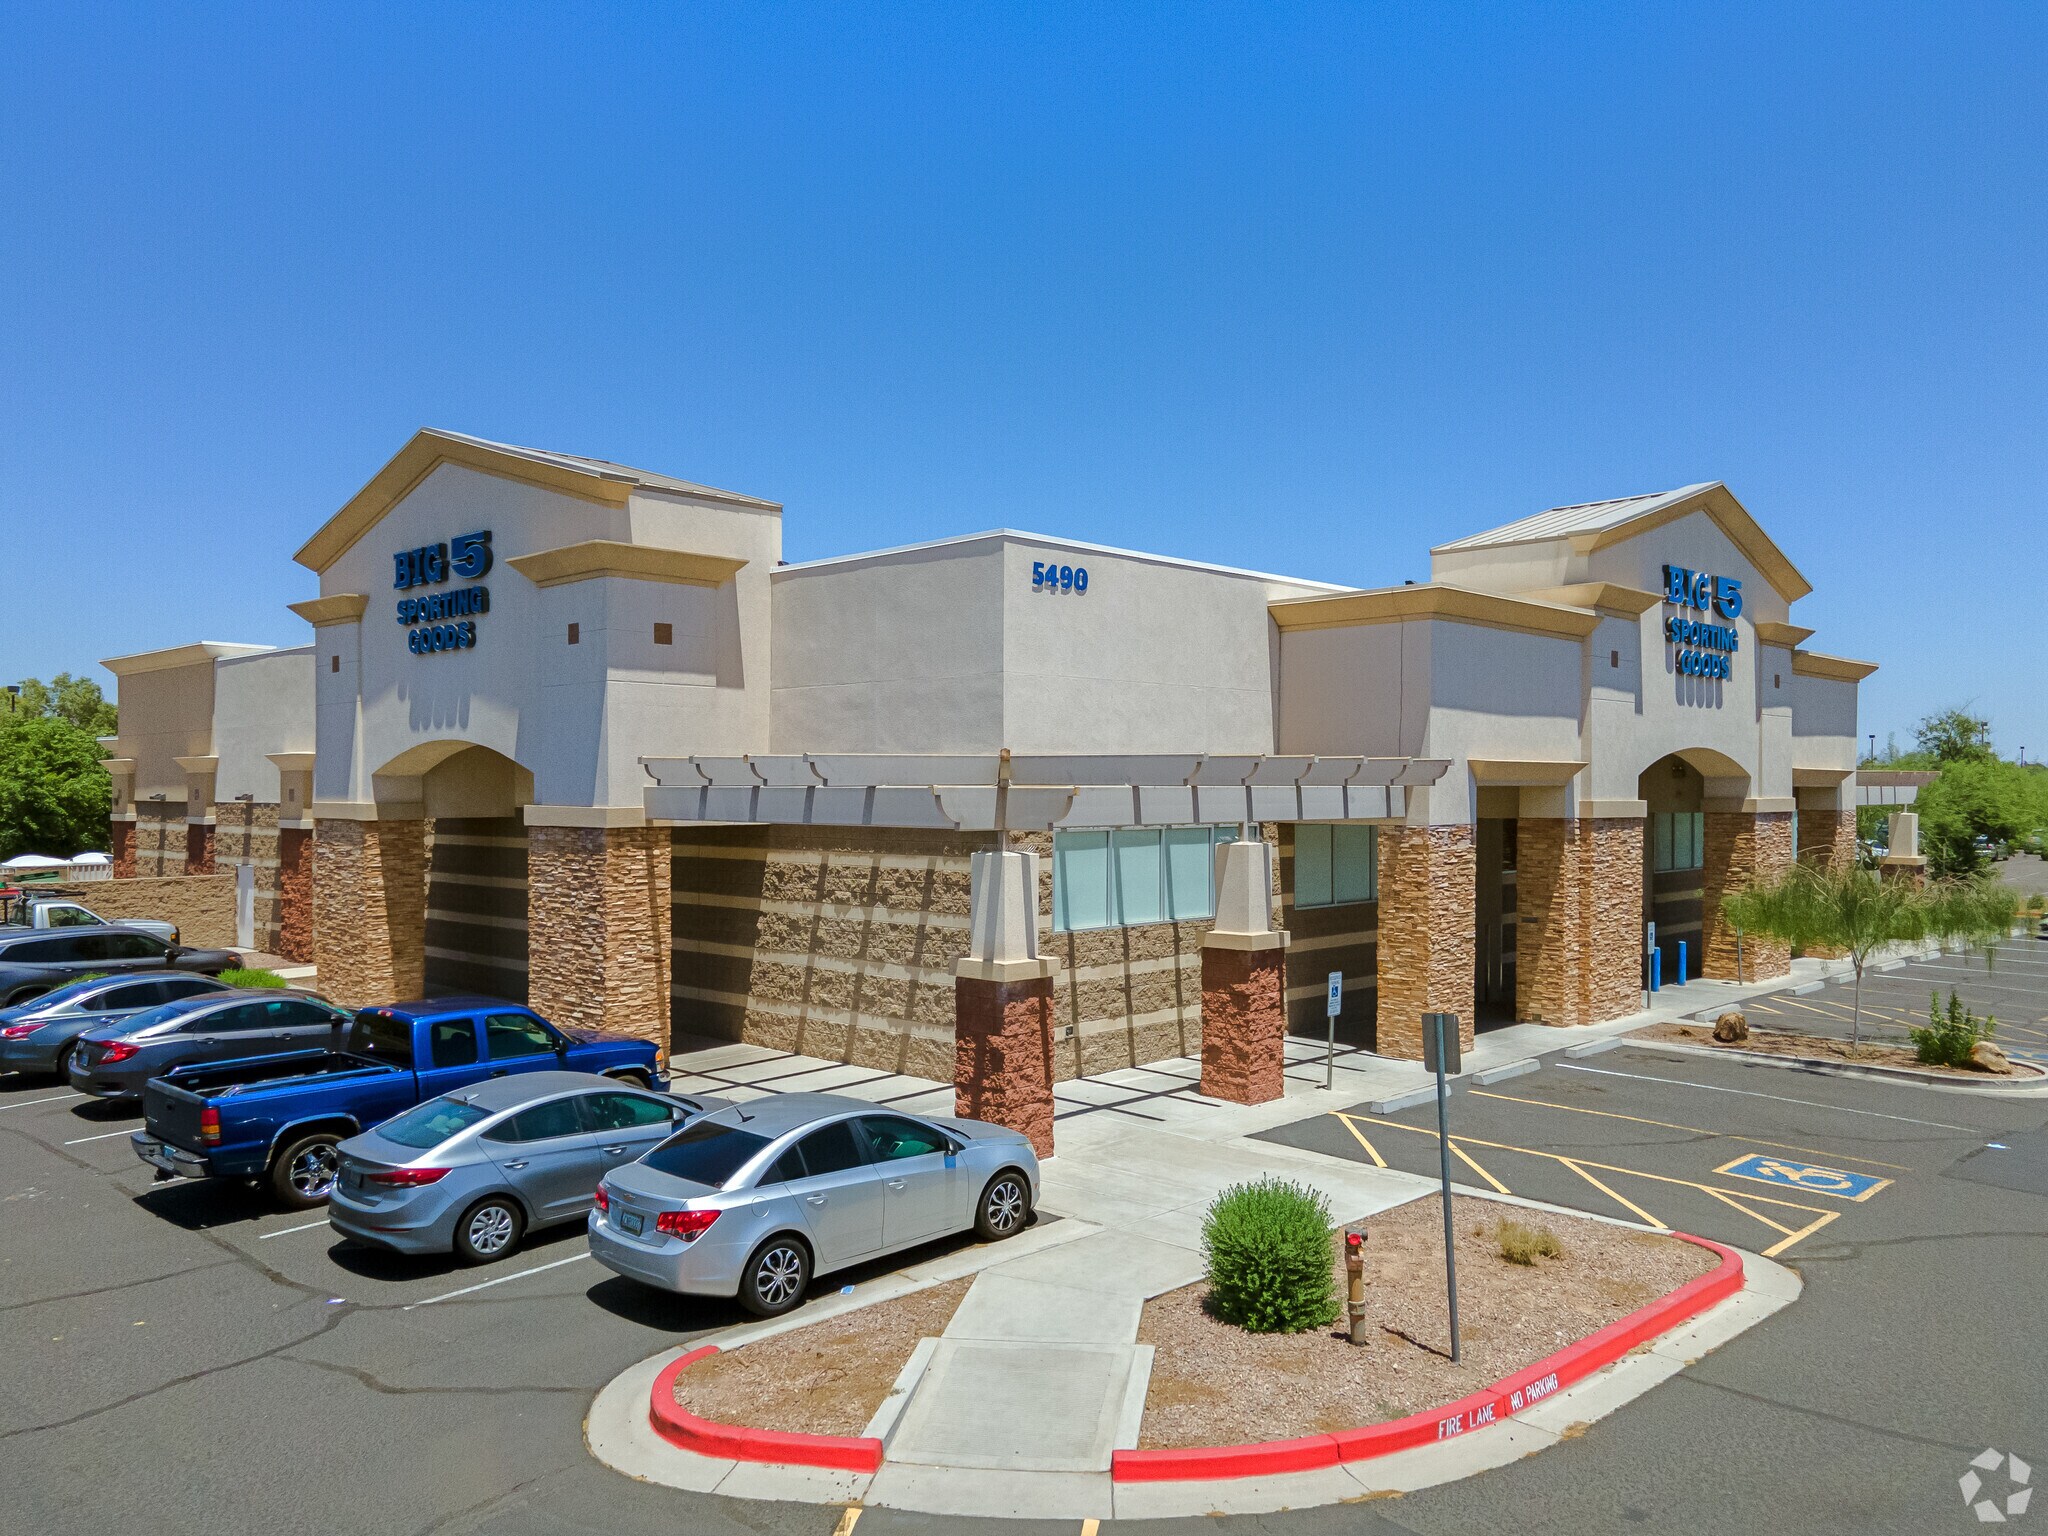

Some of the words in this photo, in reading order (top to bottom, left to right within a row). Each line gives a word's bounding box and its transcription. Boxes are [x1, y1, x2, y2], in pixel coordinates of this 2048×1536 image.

[394, 543, 449, 590] BIG
[451, 530, 493, 579] 5
[1032, 561, 1089, 591] 5490
[397, 586, 489, 625] SPORTING
[1664, 565, 1711, 611] BIG
[1712, 576, 1743, 620] 5
[408, 621, 476, 654] GOODS
[1667, 617, 1739, 652] SPORTING
[1677, 649, 1730, 680] GOODS
[1438, 1414, 1463, 1440] FIRE
[1469, 1403, 1496, 1428] LANE
[1510, 1391, 1524, 1411] NO
[1525, 1373, 1558, 1403] PARKING
